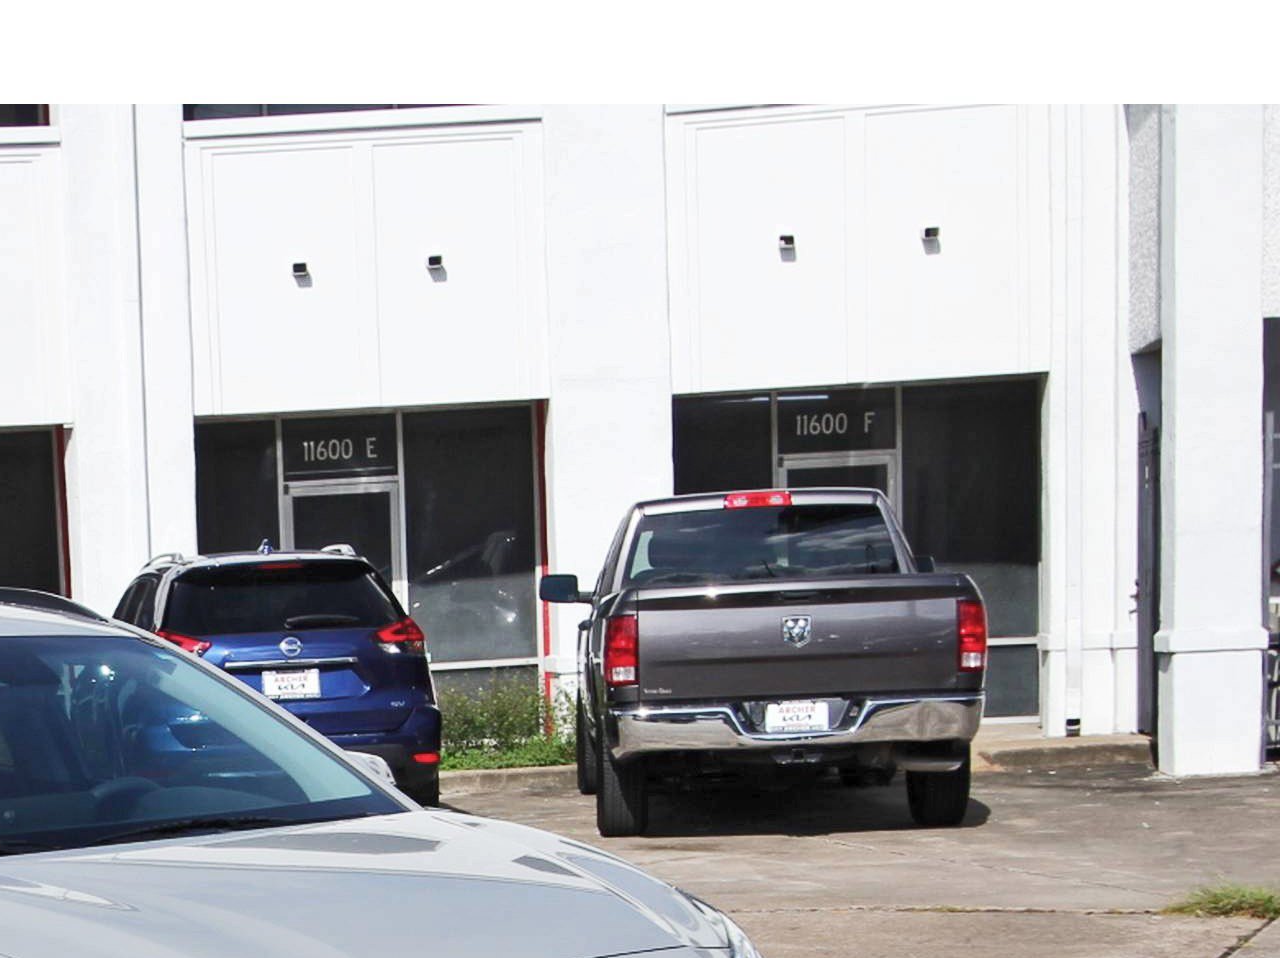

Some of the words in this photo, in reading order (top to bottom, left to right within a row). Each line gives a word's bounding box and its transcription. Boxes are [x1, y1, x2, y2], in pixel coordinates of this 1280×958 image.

[796, 413, 848, 435] 11600
[864, 412, 875, 433] F
[303, 438, 353, 461] 11600
[366, 437, 378, 458] E
